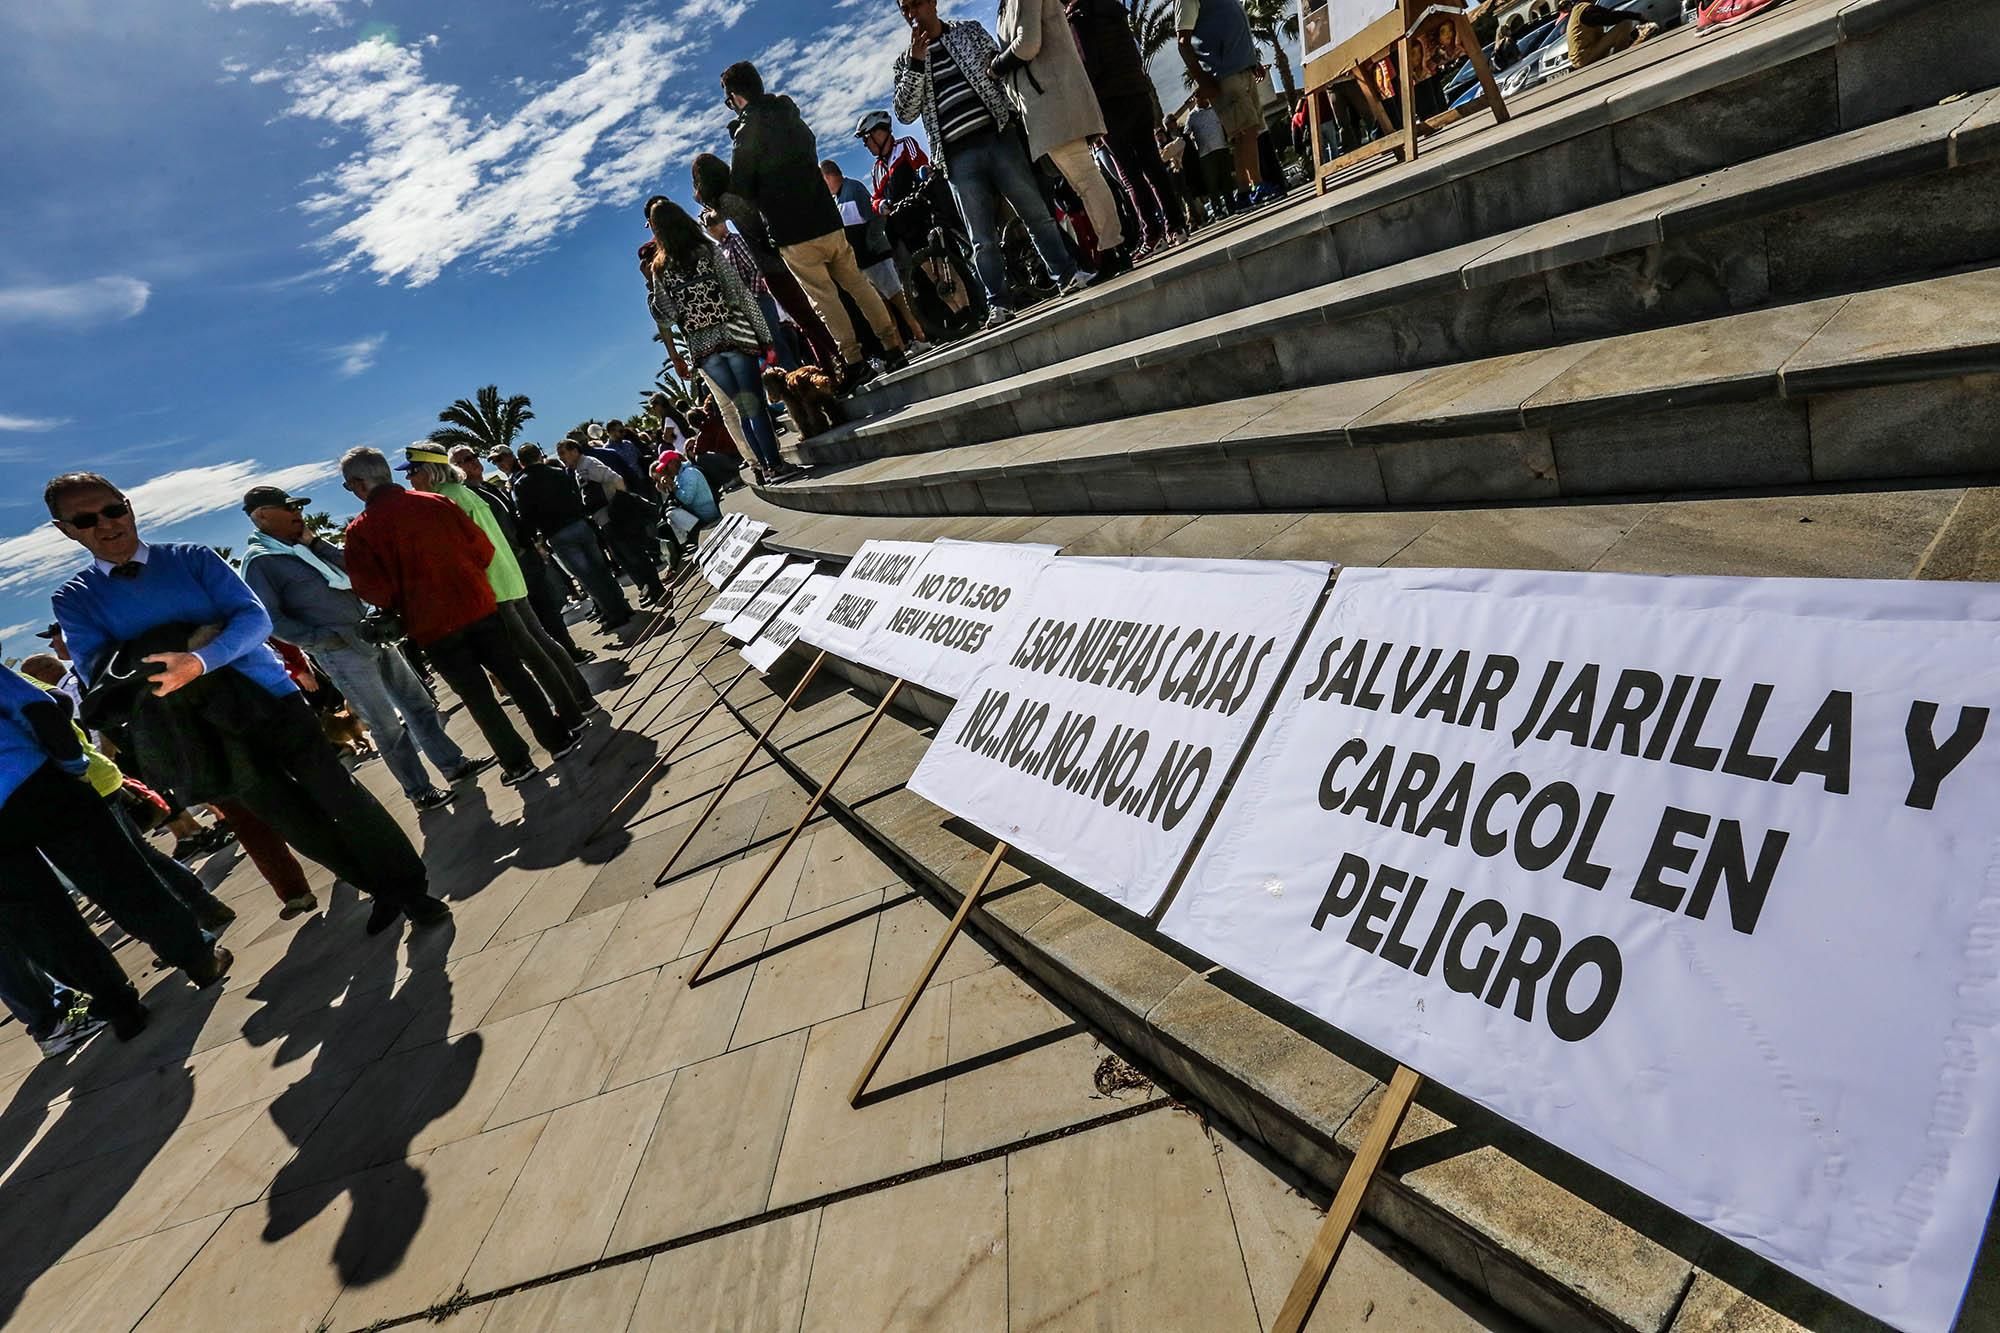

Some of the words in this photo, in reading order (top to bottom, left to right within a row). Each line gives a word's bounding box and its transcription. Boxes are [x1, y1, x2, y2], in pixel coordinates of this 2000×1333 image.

[851, 551, 884, 582] CALA
[874, 552, 917, 587] MOSCA
[911, 573, 946, 600] NO
[937, 576, 968, 604] TO
[959, 582, 1012, 613] 1.500
[825, 593, 878, 630] ERHALEN
[885, 606, 932, 637] NEW
[918, 612, 994, 654] HOUSES
[1008, 616, 1078, 676] 1.500
[1057, 616, 1182, 696] NUEVAS
[1158, 627, 1276, 717] CASAS
[1303, 636, 1520, 731] SALVAR
[1512, 660, 1854, 795] JARILLA
[1904, 700, 1991, 811] Y
[1317, 737, 1616, 892] CARACOL
[1630, 806, 1791, 936] EN
[1310, 852, 1623, 1043] PELIGRO
